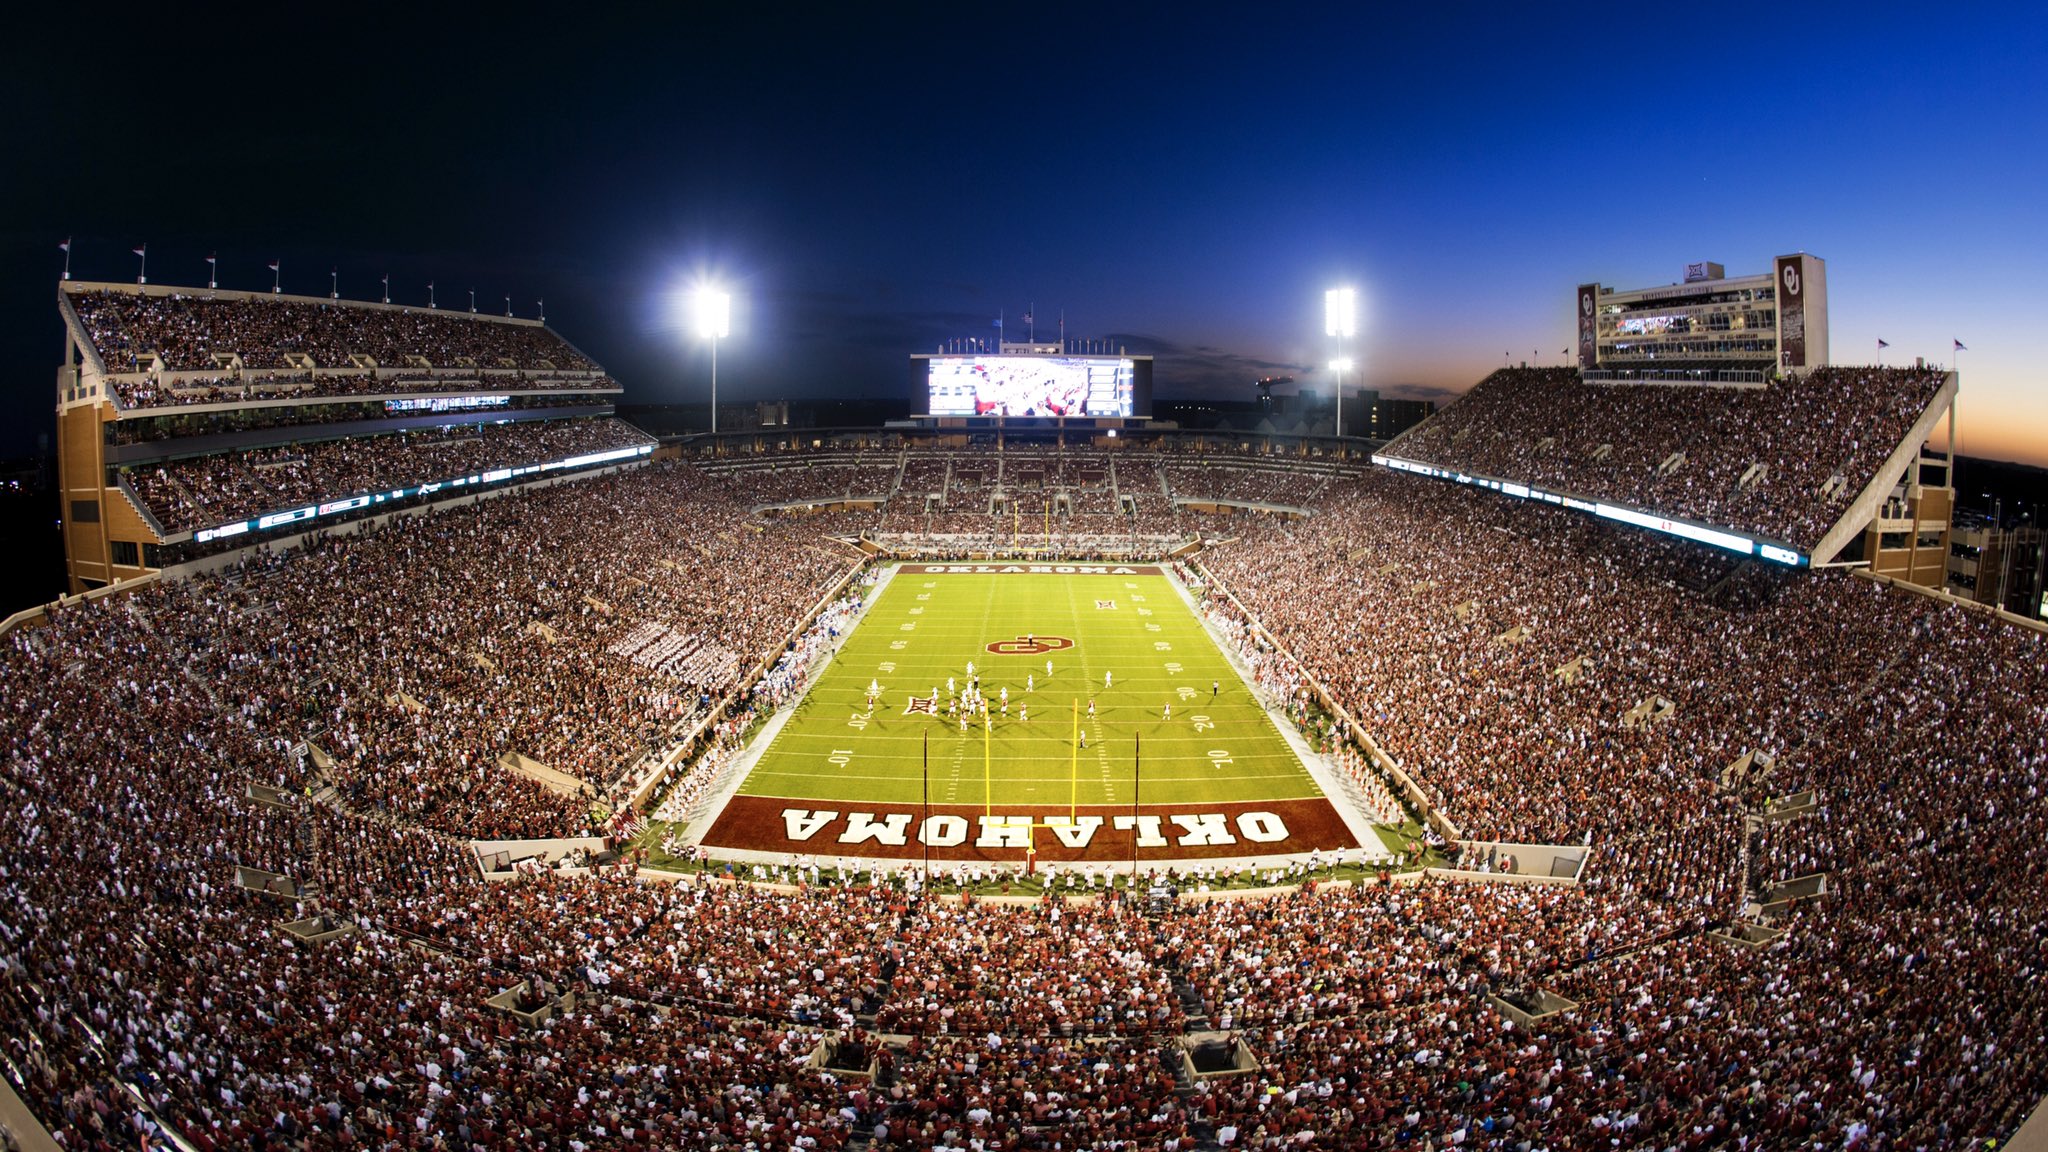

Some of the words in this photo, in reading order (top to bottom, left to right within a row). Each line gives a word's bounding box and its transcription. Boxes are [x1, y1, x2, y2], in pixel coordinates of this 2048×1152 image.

[1784, 265, 1800, 296] OU
[1583, 294, 1593, 316] OU
[924, 565, 1137, 575] OKLAHOMA
[985, 635, 1075, 656] OU
[848, 712, 873, 728] 20
[1190, 715, 1214, 729] 20
[828, 749, 853, 763] 10
[1207, 750, 1233, 764] 10
[781, 808, 1290, 848] OKLAHOMA
